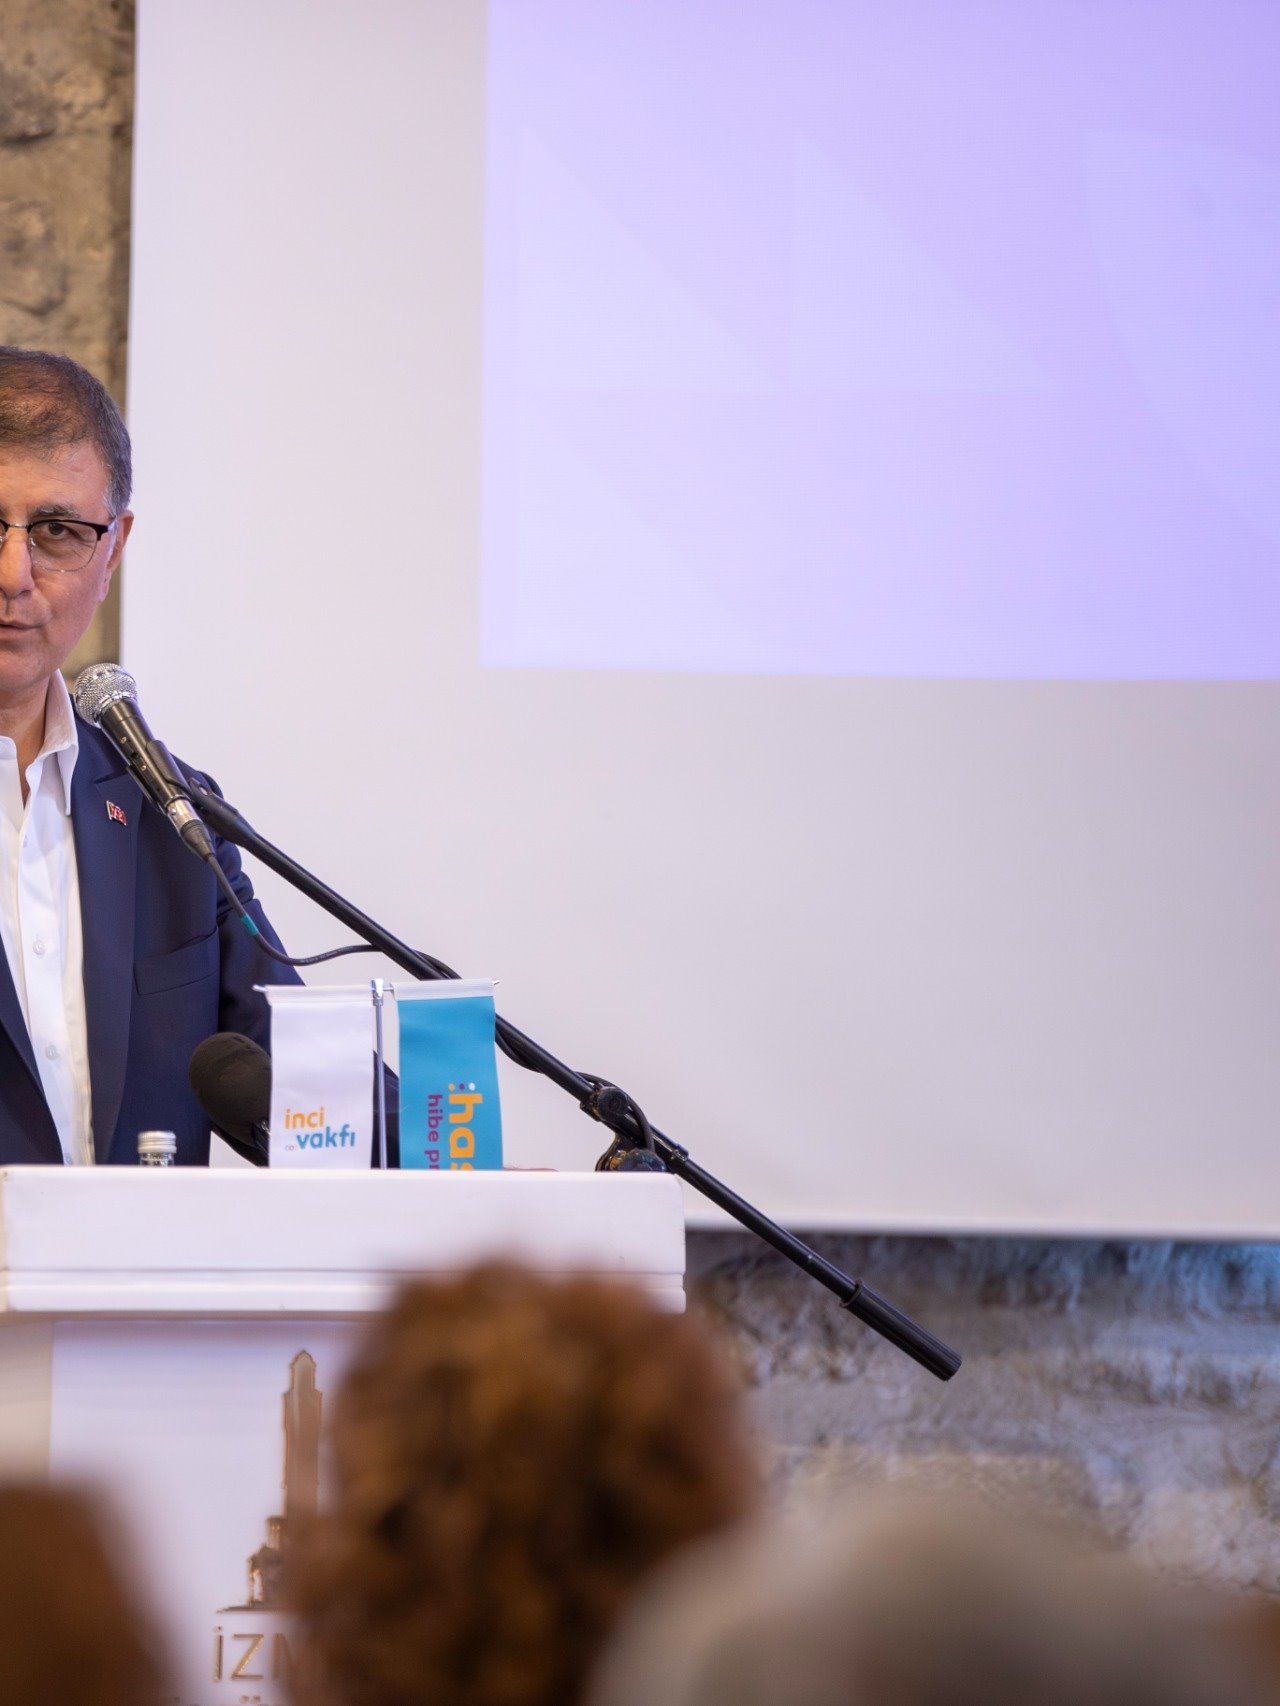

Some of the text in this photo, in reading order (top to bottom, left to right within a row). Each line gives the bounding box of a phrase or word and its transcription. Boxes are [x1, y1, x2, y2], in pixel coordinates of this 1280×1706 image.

[284, 1106, 325, 1130] inci
[428, 1094, 443, 1142] hibe
[295, 1123, 356, 1150] vakfı
